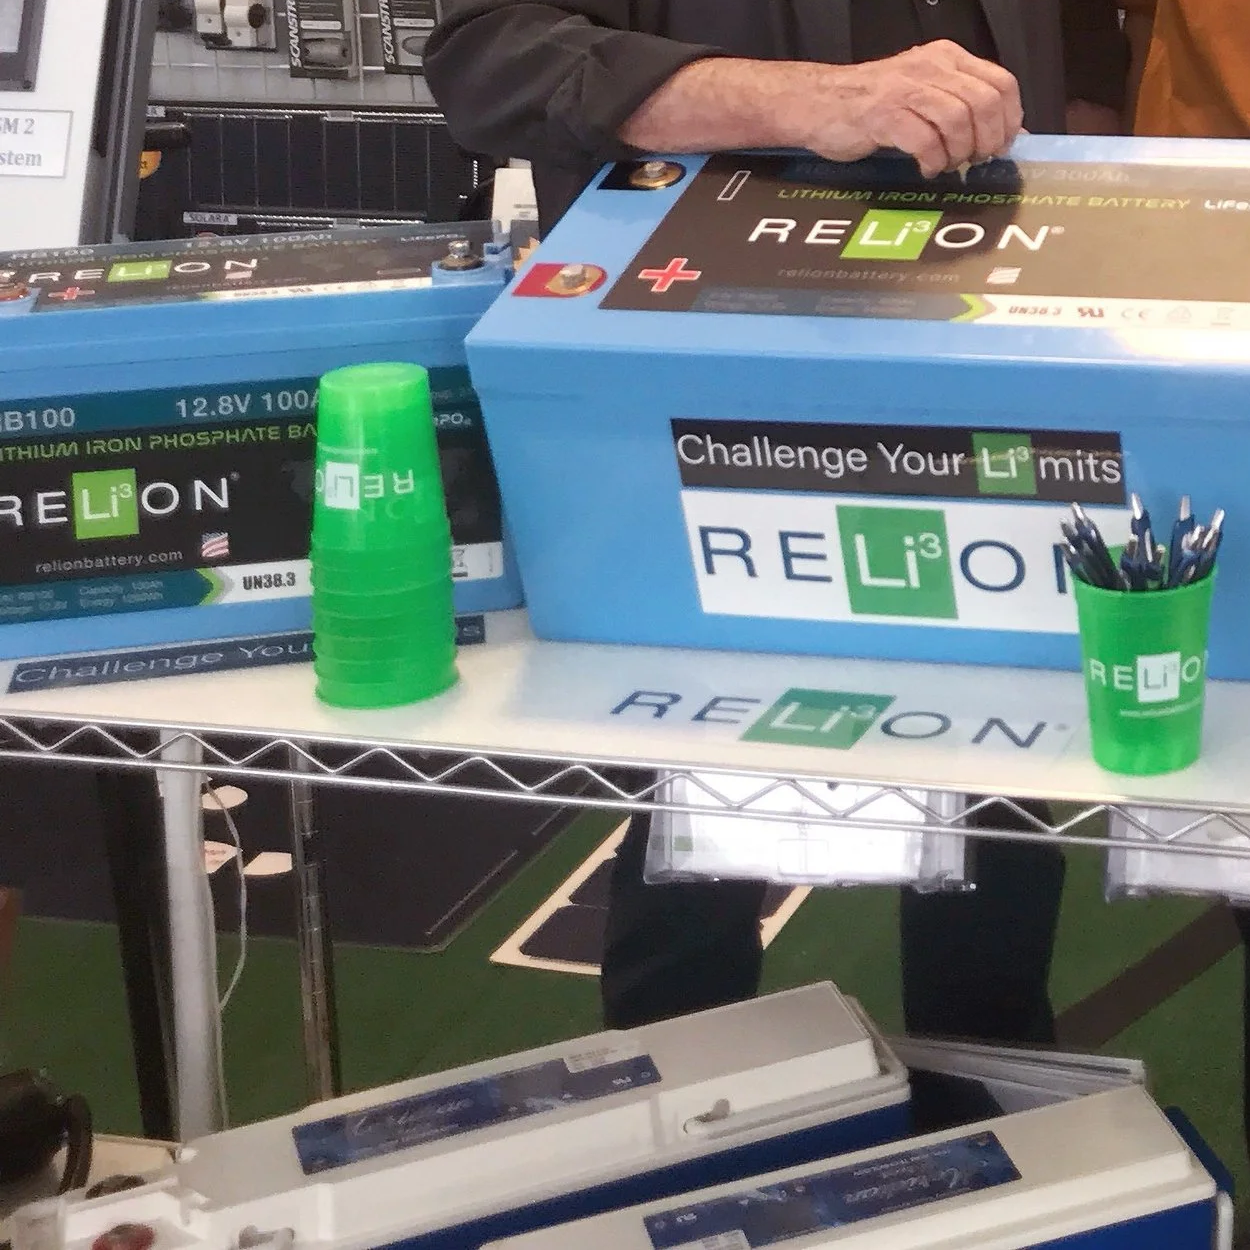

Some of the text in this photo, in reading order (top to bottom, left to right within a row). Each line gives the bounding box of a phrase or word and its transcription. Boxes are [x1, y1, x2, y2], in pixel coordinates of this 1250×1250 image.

[777, 188, 871, 201] LITHIUM
[878, 190, 937, 202] IRON
[942, 193, 1082, 207] PHOSPHATE
[1088, 196, 1191, 210] BATTERY
[175, 393, 251, 418] 12.8V
[86, 436, 142, 456] IRON
[149, 425, 281, 450] PHOSPHATE
[677, 433, 868, 479] Challenge
[877, 441, 965, 477] Your
[35, 549, 184, 574] relionbattery.com
[242, 571, 297, 591] UN38.3
[15, 642, 310, 684] Challenge You
